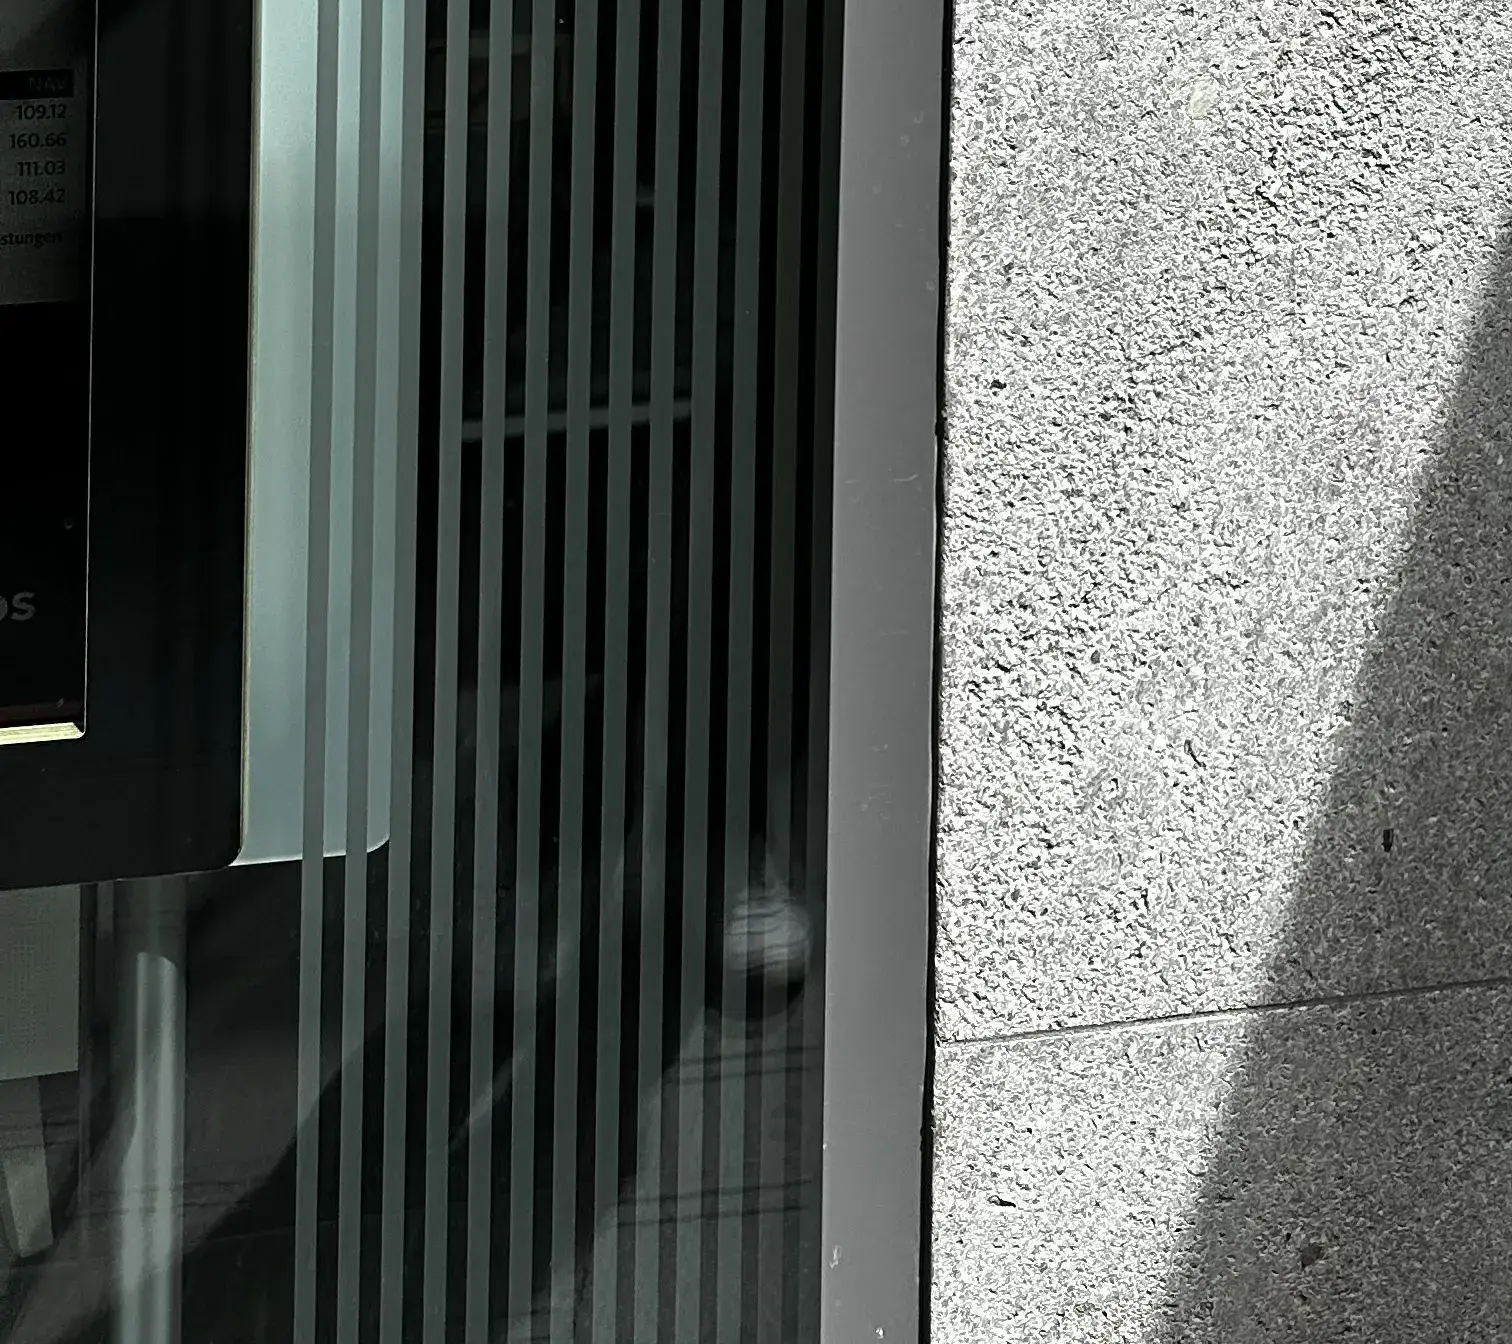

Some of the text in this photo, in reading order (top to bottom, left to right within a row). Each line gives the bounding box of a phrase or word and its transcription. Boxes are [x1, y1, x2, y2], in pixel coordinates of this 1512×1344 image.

[28, 75, 67, 92] NAV
[15, 104, 68, 120] 109.12
[9, 132, 67, 149] 160.66
[17, 160, 67, 177] 111.03
[8, 188, 66, 205] 108.42
